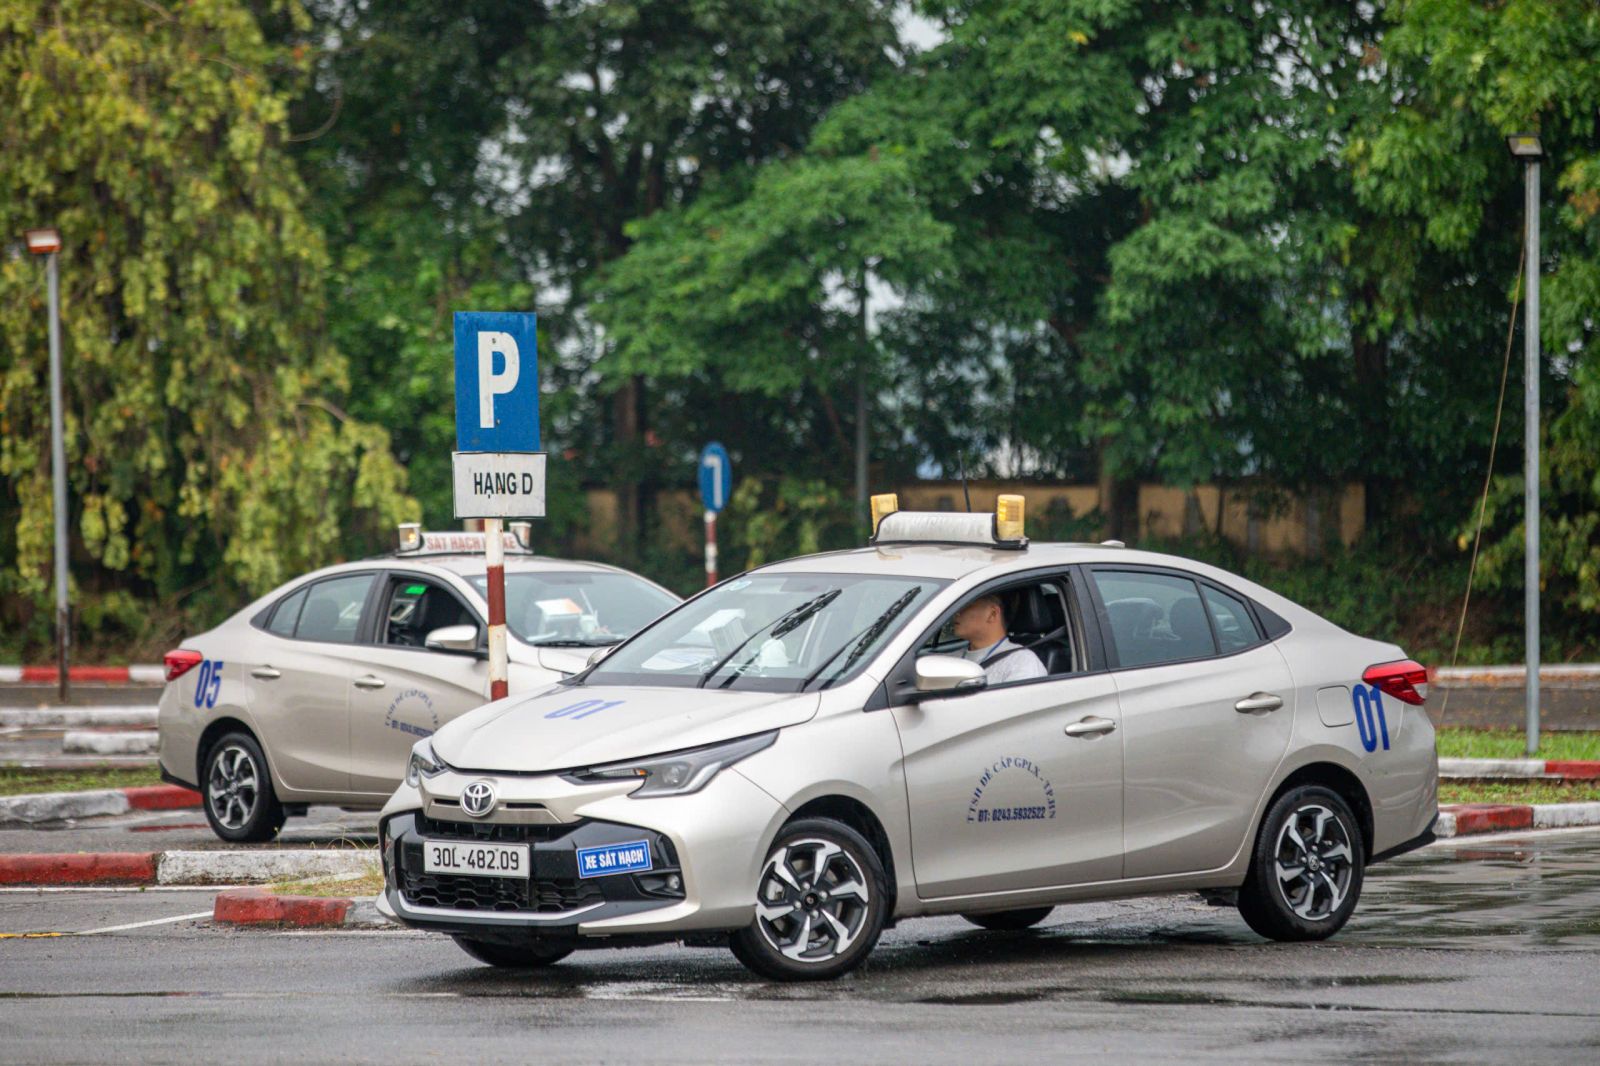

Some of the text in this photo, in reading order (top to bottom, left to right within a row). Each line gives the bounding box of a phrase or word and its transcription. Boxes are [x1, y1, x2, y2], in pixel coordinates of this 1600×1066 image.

[478, 331, 520, 428] P
[474, 472, 533, 498] HẠNG D
[194, 659, 224, 709] 05
[543, 699, 626, 720] 01
[1352, 684, 1390, 753] 01
[584, 848, 644, 870] XE SÁT HẠCH
